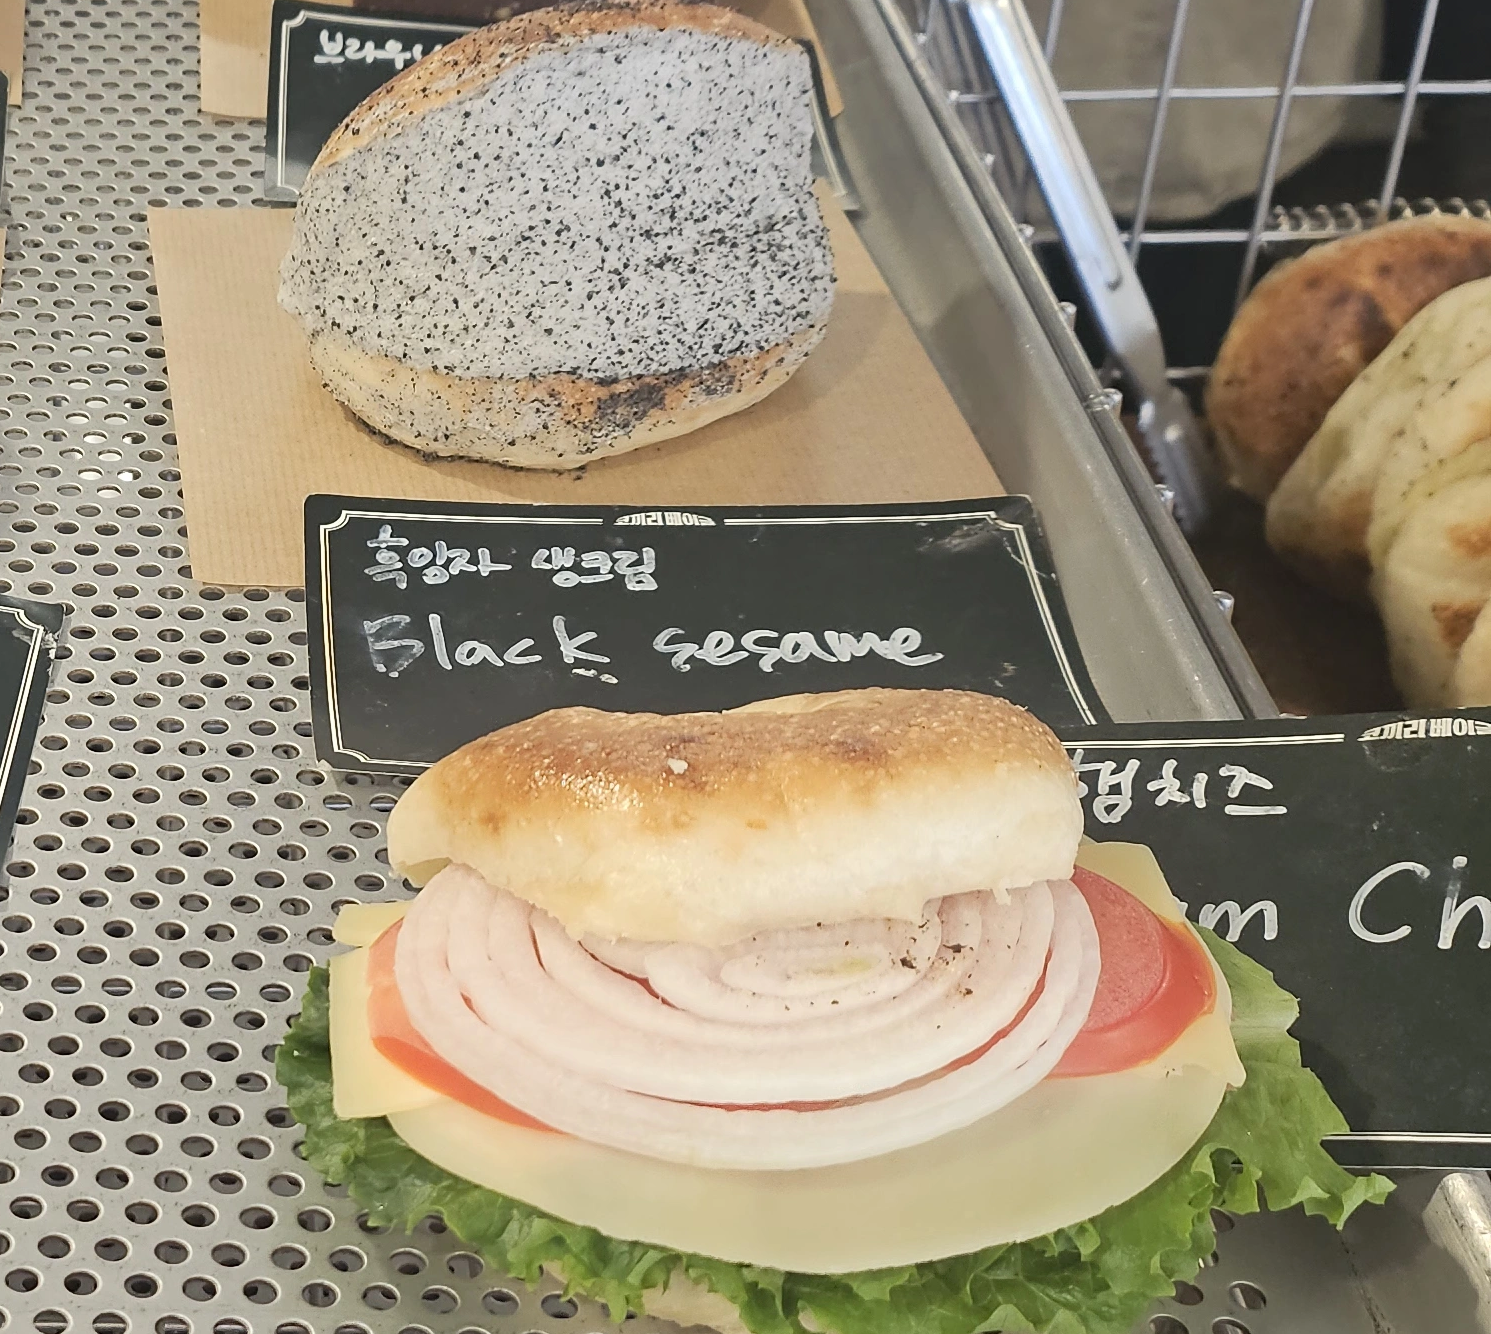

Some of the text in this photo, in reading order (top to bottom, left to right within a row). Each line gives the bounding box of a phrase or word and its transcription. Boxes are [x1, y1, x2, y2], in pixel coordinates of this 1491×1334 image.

[531, 546, 659, 592] 생크림
[362, 613, 945, 678] Black sesame
